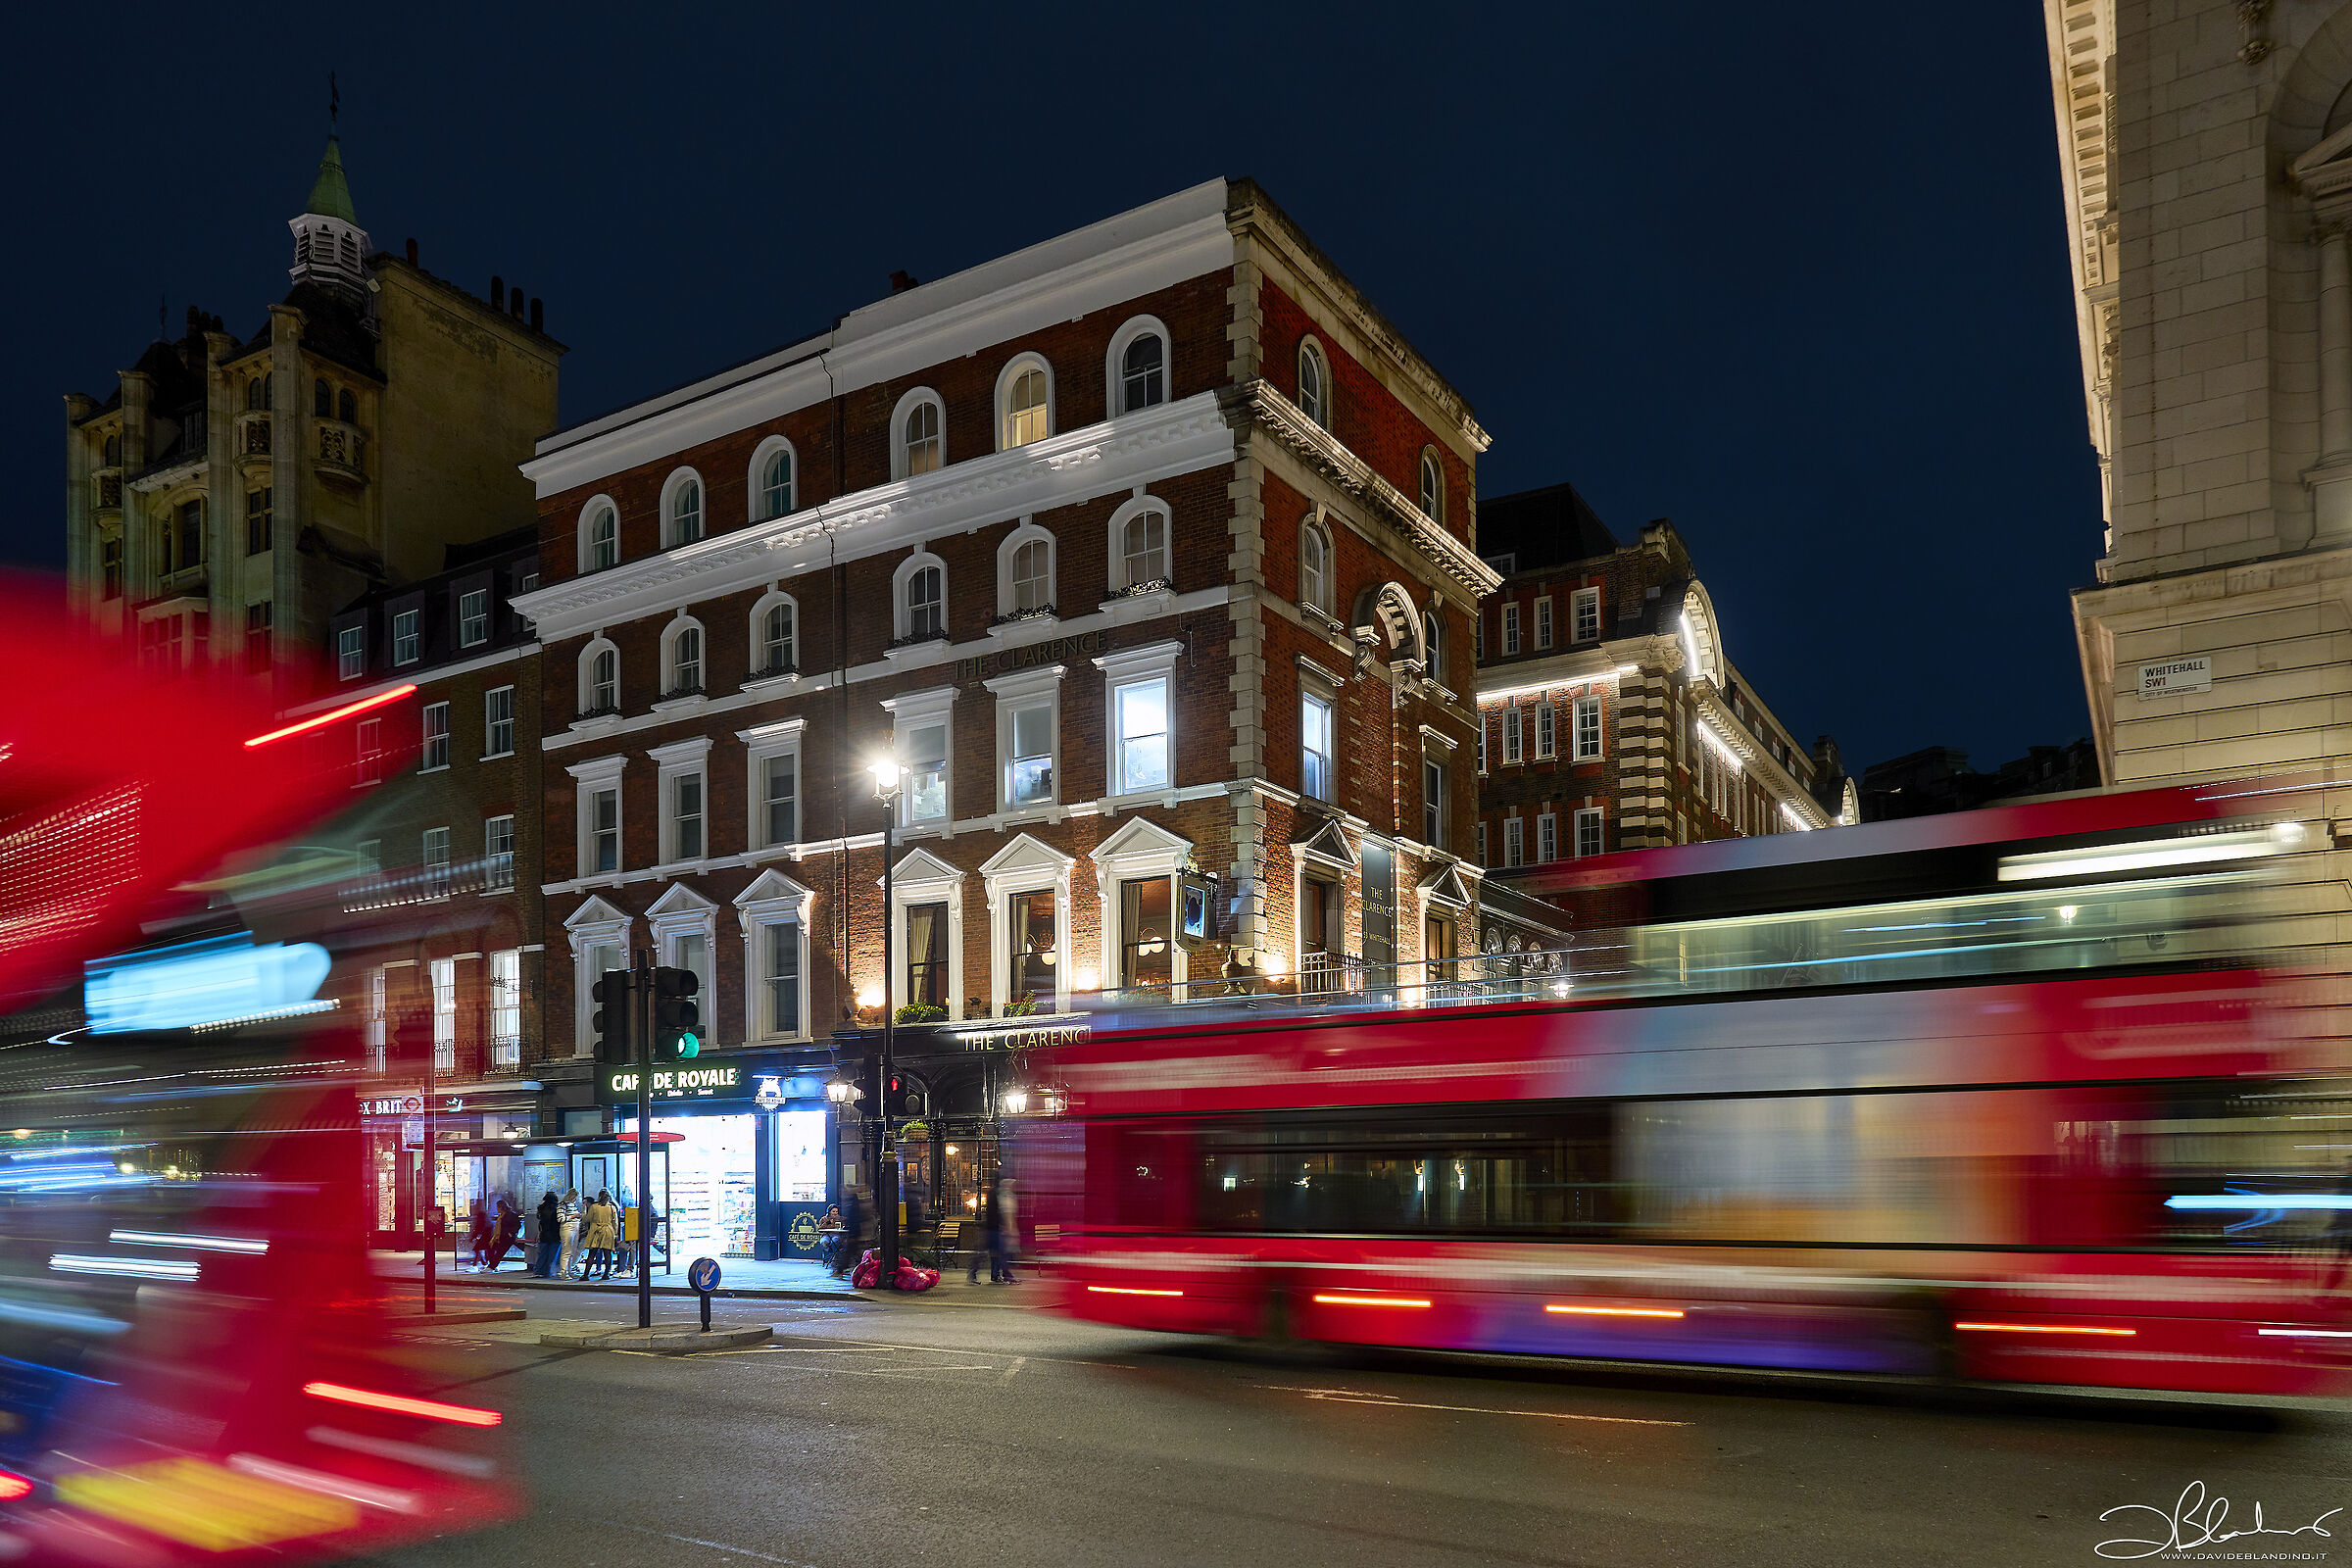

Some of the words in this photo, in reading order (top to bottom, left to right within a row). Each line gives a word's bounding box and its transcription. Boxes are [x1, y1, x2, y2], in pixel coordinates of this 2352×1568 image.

[955, 654, 991, 681] THE
[997, 631, 1107, 671] CLARENCE
[2144, 661, 2206, 678] WHITEHALL
[2144, 676, 2167, 689] SW1
[1370, 886, 1383, 900] THE
[1361, 899, 1393, 918] CLARENCE
[963, 1033, 995, 1052] THE
[612, 1073, 640, 1092] CAF
[653, 1072, 674, 1090] DE
[677, 1067, 737, 1088] ROYALE
[375, 1100, 403, 1115] BRIT
